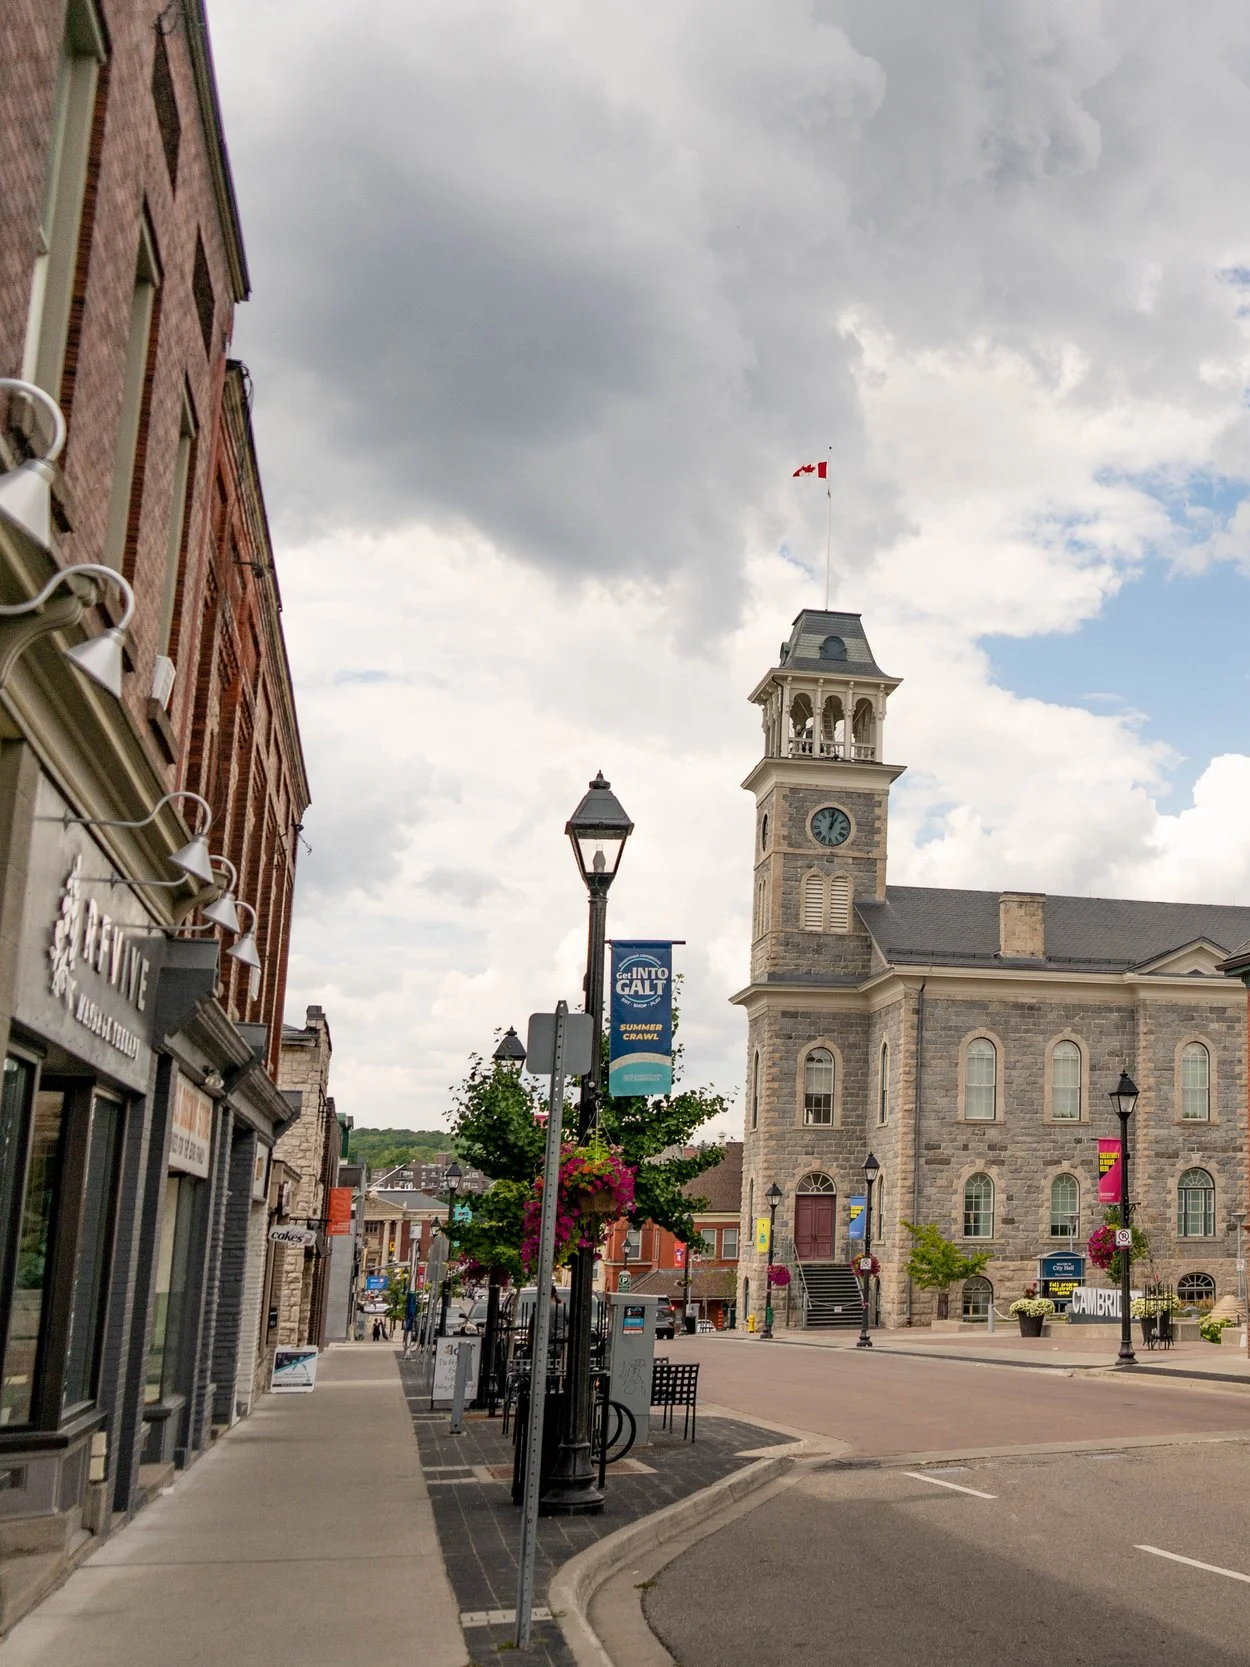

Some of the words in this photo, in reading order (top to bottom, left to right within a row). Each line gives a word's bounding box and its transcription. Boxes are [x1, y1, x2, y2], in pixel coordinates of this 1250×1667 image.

[632, 967, 669, 979] INTO
[615, 979, 667, 995] GALT
[619, 1023, 663, 1031] SUMMER
[622, 1033, 660, 1041] CRAWL
[271, 1231, 303, 1243] cakes
